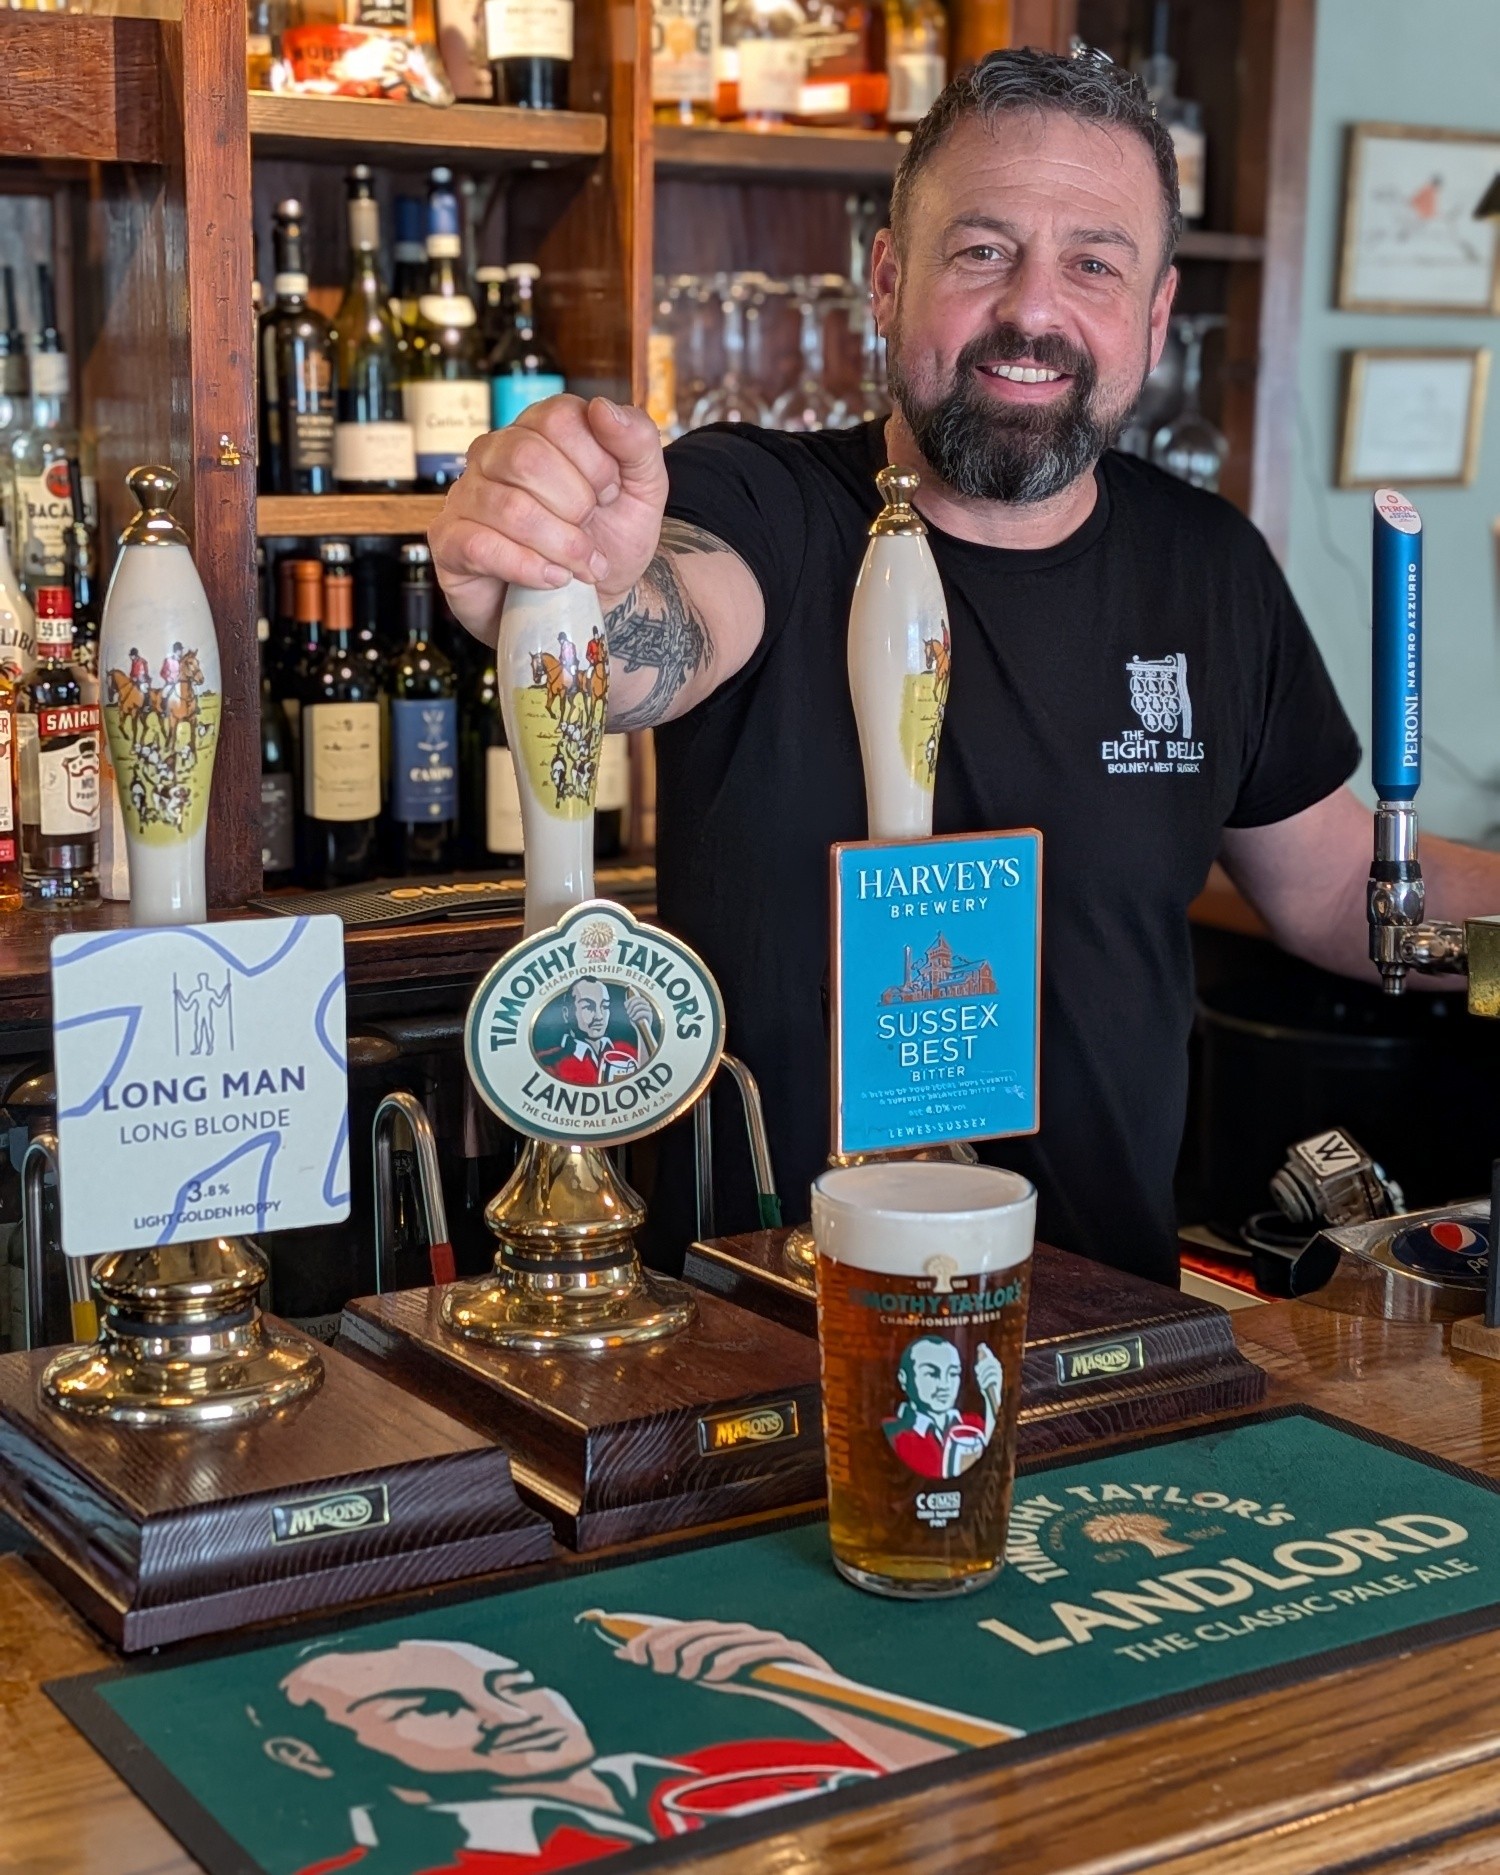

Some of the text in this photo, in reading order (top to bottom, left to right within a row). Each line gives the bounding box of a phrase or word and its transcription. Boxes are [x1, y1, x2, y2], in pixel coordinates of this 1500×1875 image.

[1403, 563, 1418, 768] PERONI NASTRO AZZURRO
[1102, 740, 1204, 760] EIGHT BELLS
[1121, 730, 1145, 741] THE
[858, 858, 1020, 899] HARVEY'S
[890, 897, 988, 918] BREWERY
[490, 939, 705, 1052] TIMOTHY TAYLOR'S
[538, 964, 657, 996] CHAMPIONSHIP BEERS
[879, 1003, 999, 1039] SUSSEX
[901, 1035, 978, 1066] BEST
[103, 1065, 305, 1111] LONG MAN
[521, 1062, 673, 1117] LANDLORD
[912, 1065, 965, 1082] BITTER
[120, 1108, 290, 1145] LONG BLONDE
[521, 1101, 540, 1117] THE
[540, 1111, 581, 1128] CLASSIC
[583, 1117, 607, 1128] PALE
[610, 1113, 629, 1125] ALE
[631, 1104, 650, 1119] ABV
[937, 1117, 986, 1133] SUSSEX
[134, 1200, 281, 1230] LIGHT GOLDEN HOPPY
[1065, 1483, 1296, 1526] TAYLOR'S
[977, 1514, 1469, 1657] LANDLORD
[1114, 1557, 1479, 1662] THE CLASSIC PALE ALE
